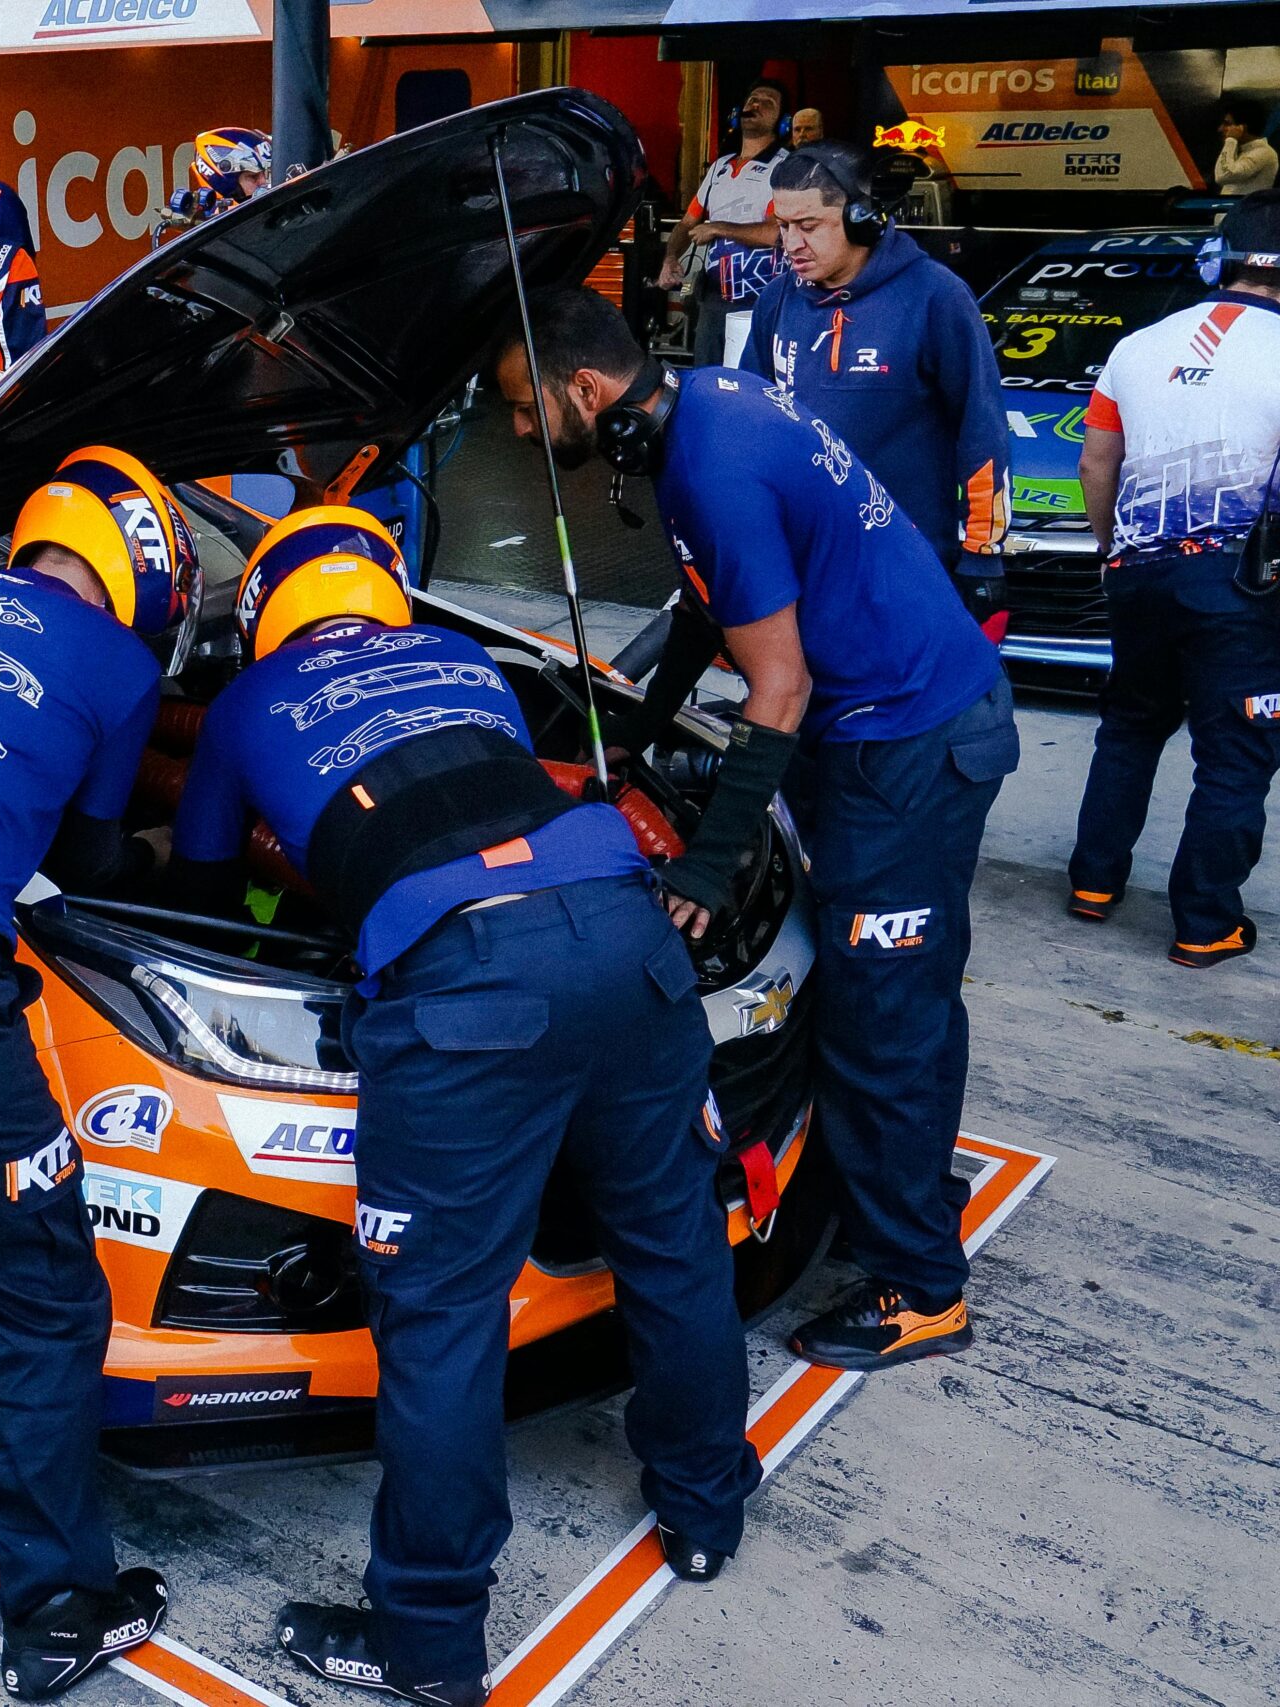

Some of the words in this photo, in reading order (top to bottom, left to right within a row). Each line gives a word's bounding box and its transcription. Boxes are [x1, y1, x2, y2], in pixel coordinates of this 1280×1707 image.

[912, 65, 1056, 96] icarros
[1077, 73, 1118, 90] Itaú
[980, 121, 1111, 142] ACDelco
[1065, 165, 1121, 176] BOND
[1067, 154, 1120, 165] TEK
[1251, 254, 1279, 266] KTF
[23, 284, 42, 306] KT
[1005, 313, 1124, 326] BAPTISTA
[1002, 327, 1057, 359] 3
[786, 340, 798, 387] SPORTS
[1174, 366, 1215, 385] KTF
[120, 497, 171, 573] KTF
[131, 537, 148, 574] SPORTS
[238, 565, 262, 631] KTF
[859, 908, 932, 949] KTF
[894, 935, 924, 948] SPORTS
[90, 1095, 162, 1136] CBA
[18, 1126, 74, 1192] KTF
[55, 1160, 77, 1185] SPORTS
[85, 1176, 162, 1213] EK
[87, 1204, 161, 1238] OND
[355, 1198, 412, 1248] KTF
[368, 1240, 400, 1256] SPORTS
[188, 1388, 303, 1406] HANKOOK
[103, 1618, 148, 1647] sparco
[325, 1656, 383, 1680] sparco
